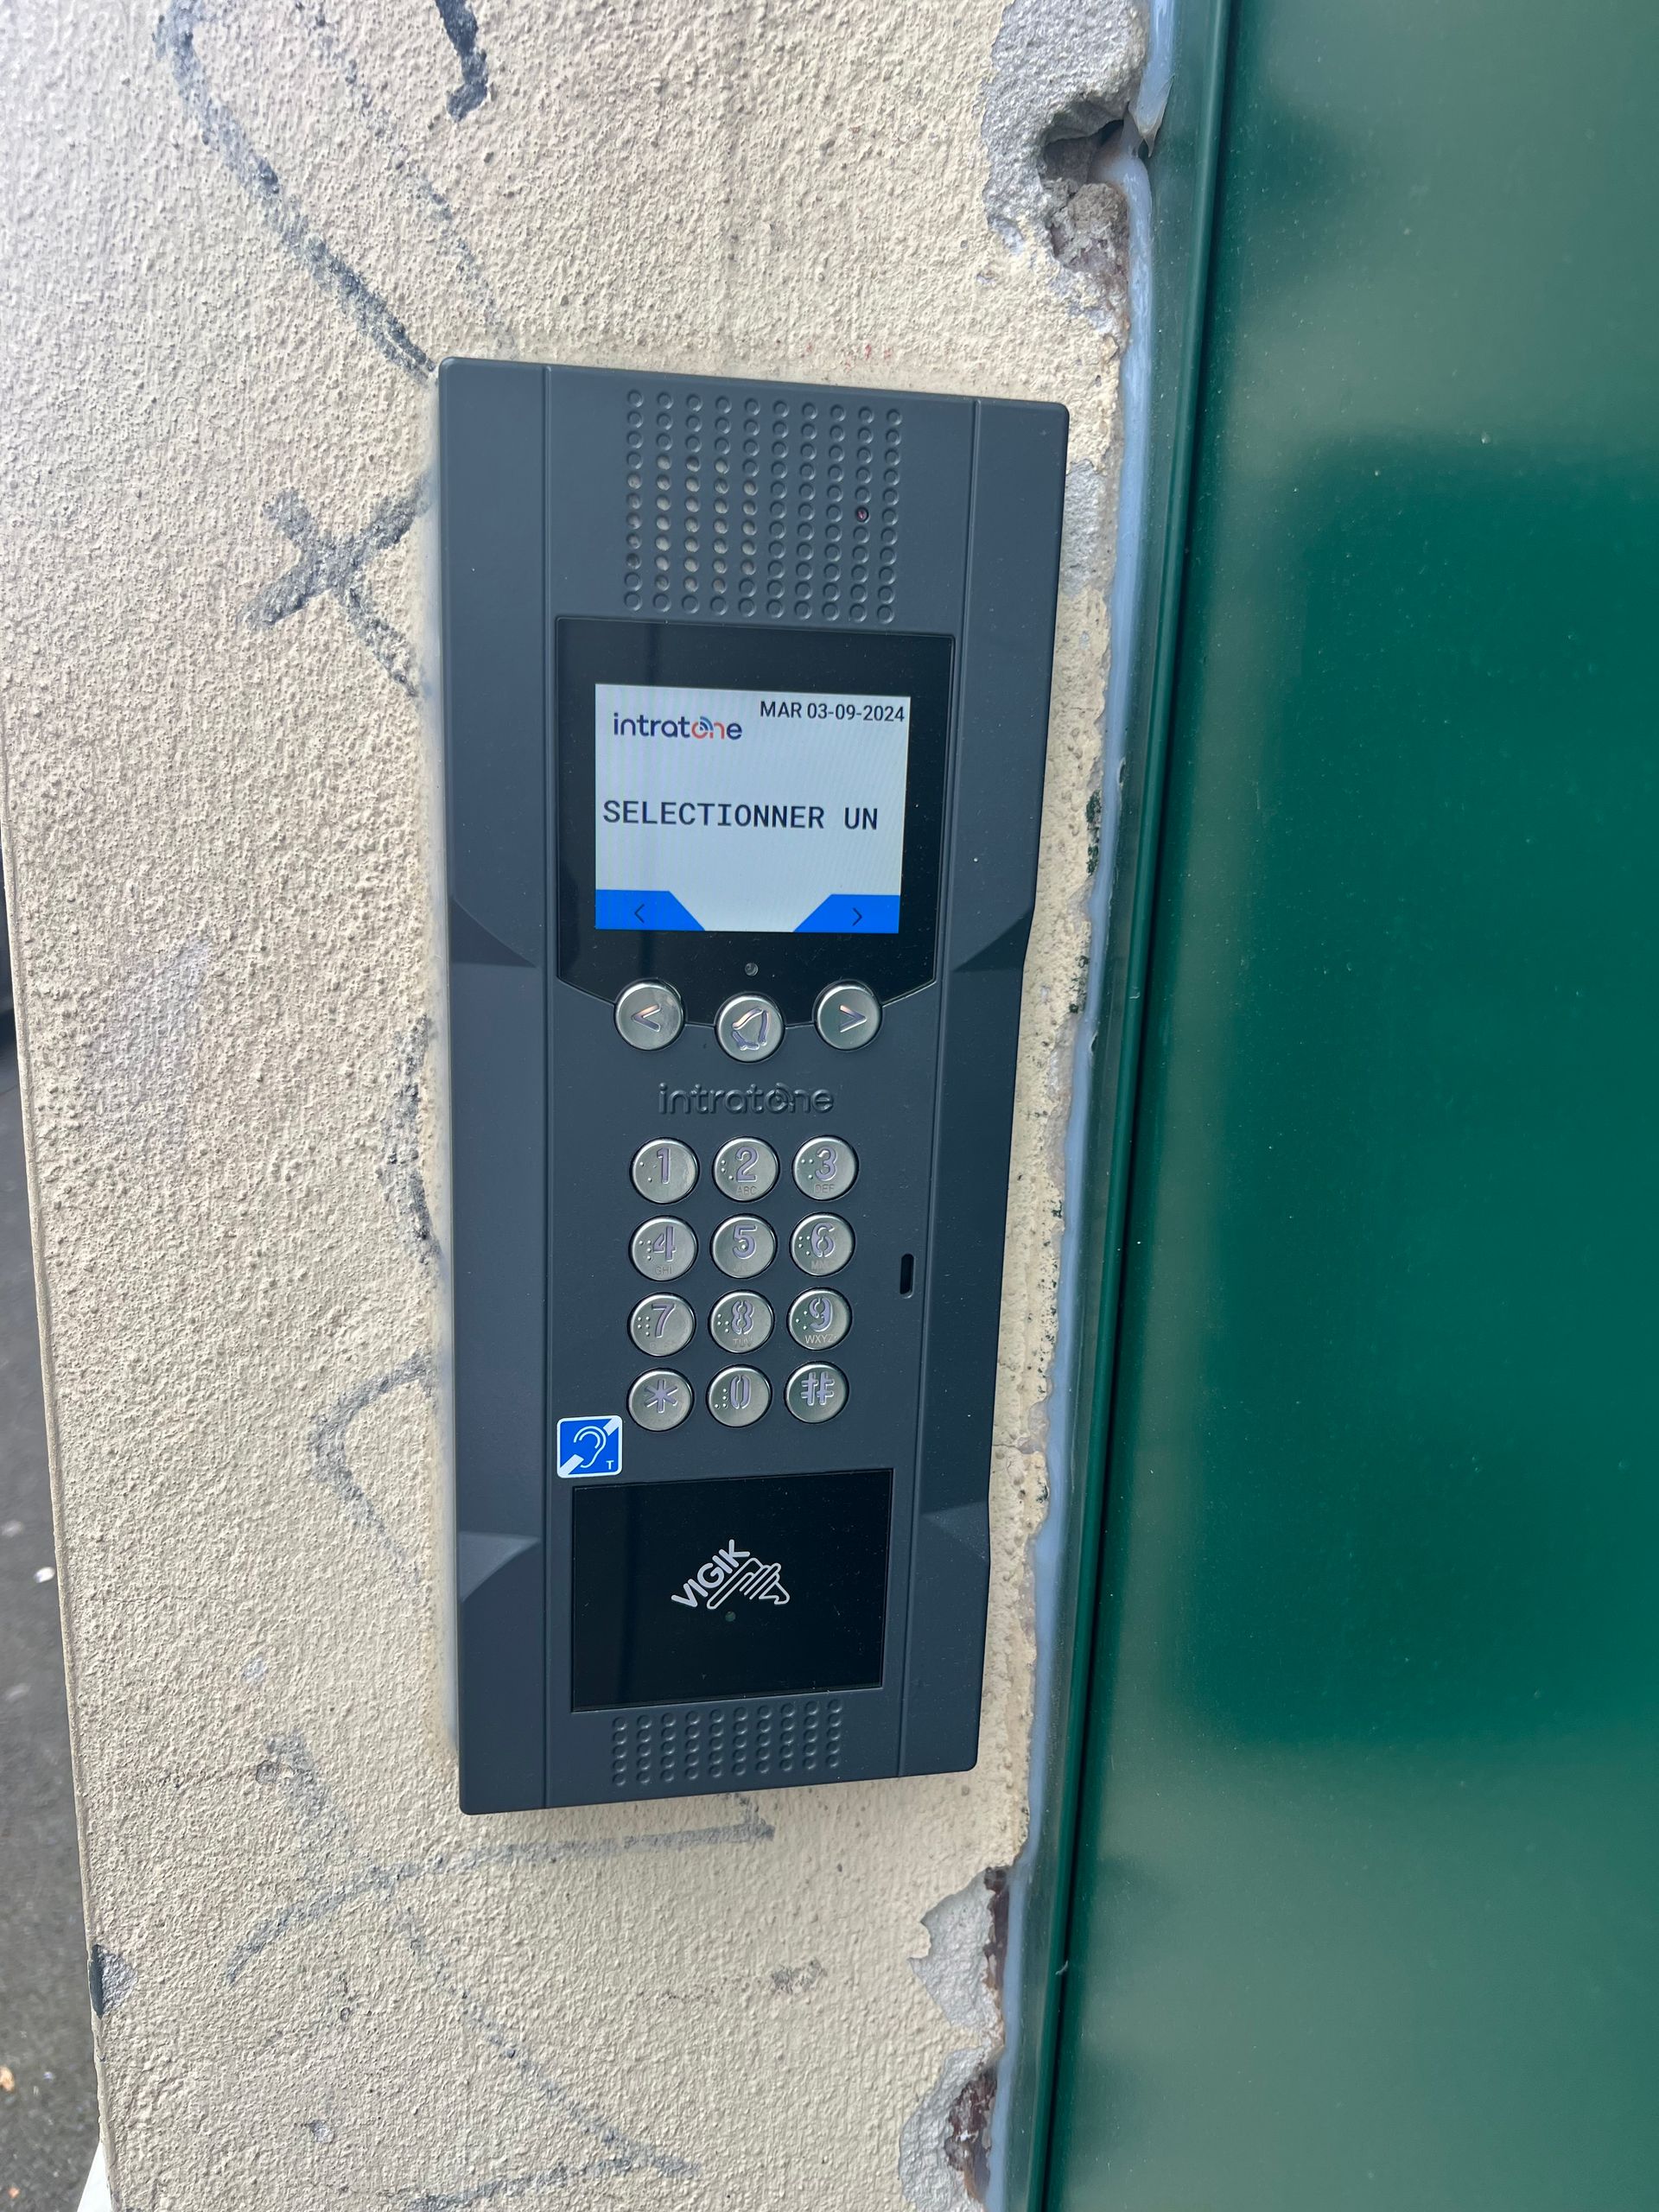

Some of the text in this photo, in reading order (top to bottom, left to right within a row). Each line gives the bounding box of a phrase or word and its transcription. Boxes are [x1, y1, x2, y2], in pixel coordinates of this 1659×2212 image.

[613, 712, 742, 741] intratone
[760, 701, 905, 722] MAR 03-09-2024
[603, 799, 878, 830] SELECTIONNER UN
[658, 1082, 835, 1115] intratone
[656, 1147, 671, 1184] 1
[735, 1147, 759, 1182] 2
[814, 1147, 837, 1181] 3
[735, 1185, 758, 1196] ABC
[814, 1184, 836, 1194] DEF
[652, 1225, 677, 1262] 4
[732, 1224, 757, 1260] 5
[810, 1223, 835, 1257] 6
[651, 1303, 676, 1338] 7
[730, 1300, 754, 1335] 8
[809, 1297, 834, 1332] 9
[730, 1375, 752, 1409] 0
[606, 1459, 614, 1470] T
[671, 1539, 751, 1608] VIGIK
